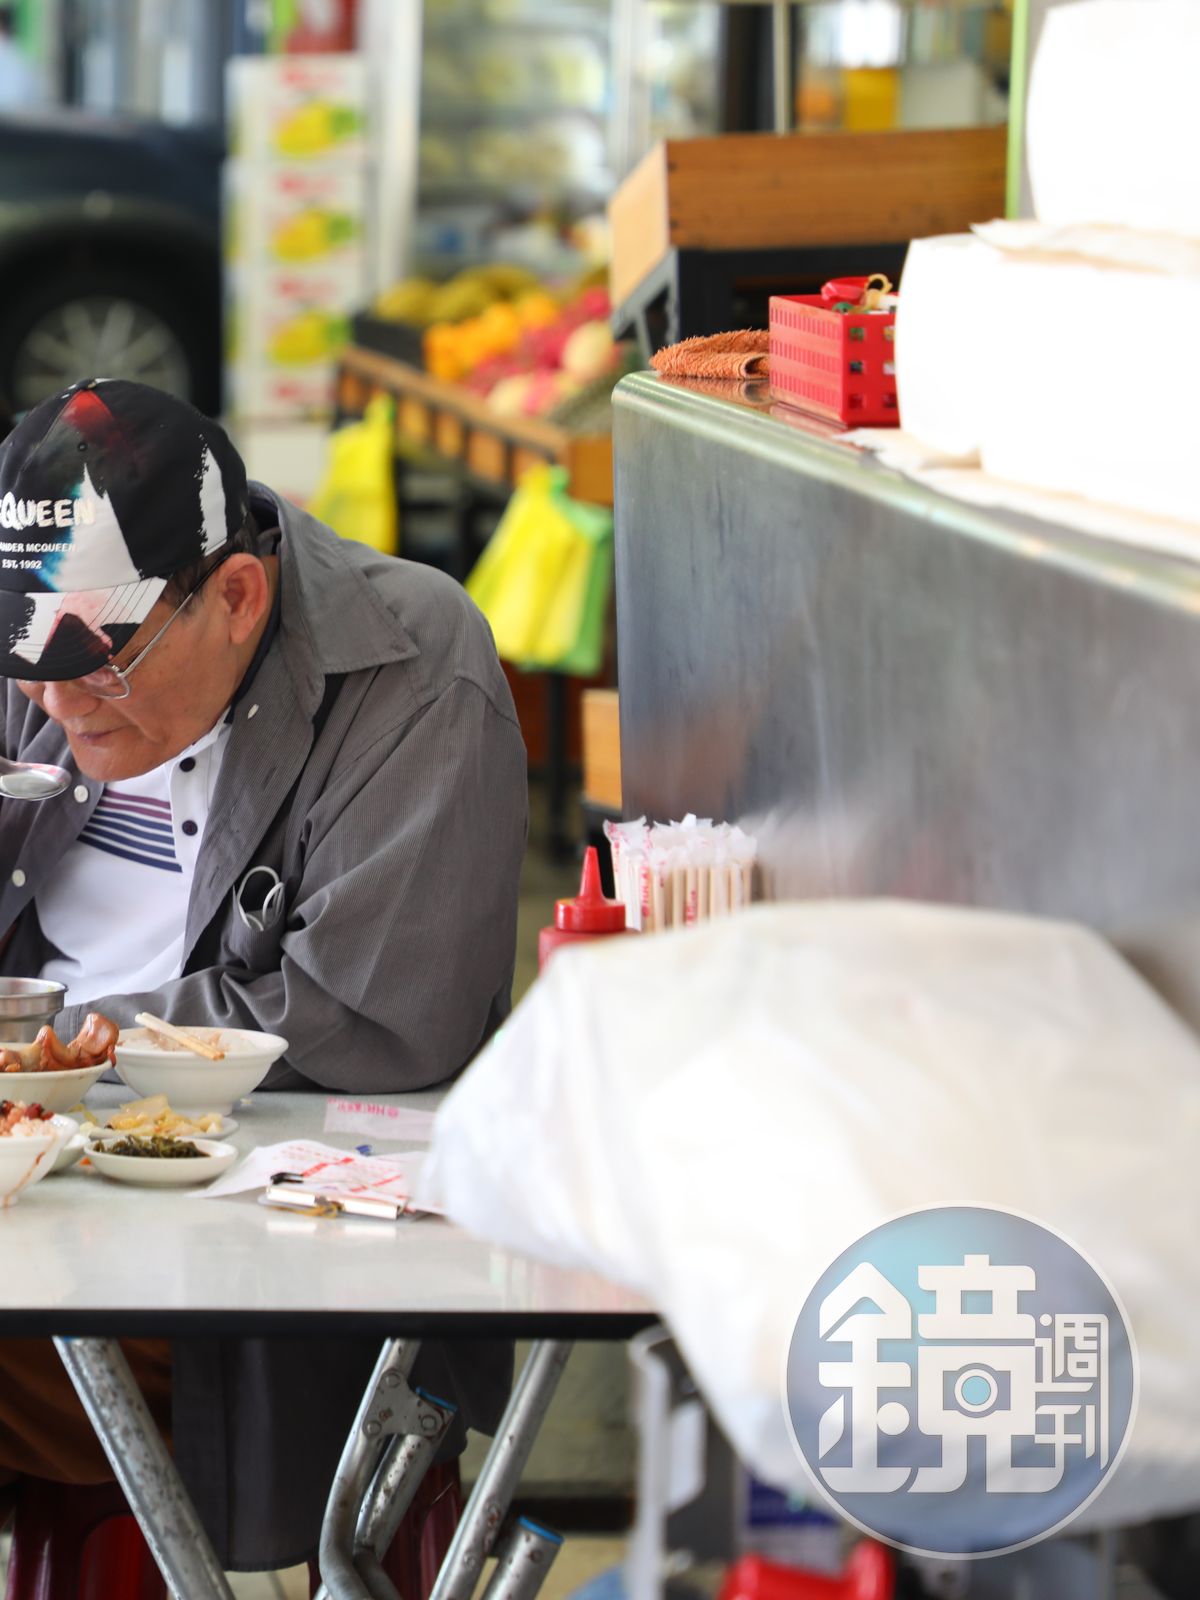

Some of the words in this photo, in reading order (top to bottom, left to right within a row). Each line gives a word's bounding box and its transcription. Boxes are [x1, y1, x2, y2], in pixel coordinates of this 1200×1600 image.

[26, 542, 77, 553] MCQUEEN
[1, 558, 18, 569] EST.
[19, 559, 42, 569] 1992
